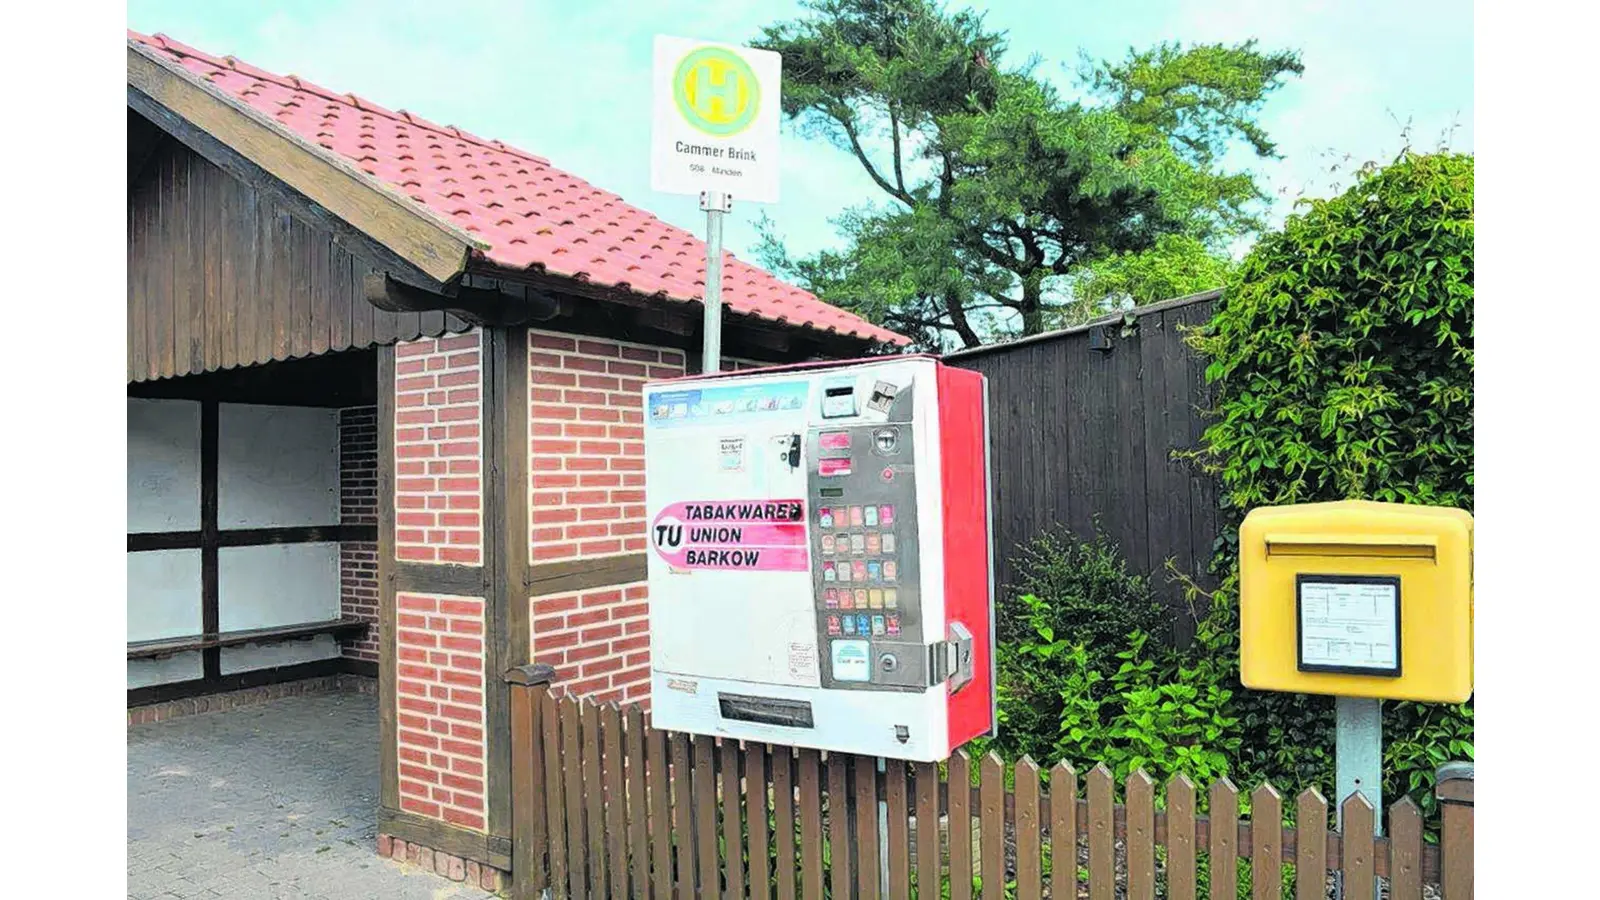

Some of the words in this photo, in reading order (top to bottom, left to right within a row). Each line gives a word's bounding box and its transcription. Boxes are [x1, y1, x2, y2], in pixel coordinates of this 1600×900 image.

[697, 66, 738, 114] H
[675, 140, 725, 158] Cammer
[728, 147, 757, 162] Brink
[656, 524, 682, 547] TU
[690, 527, 742, 543] UNION
[686, 550, 760, 567] BARKOW
